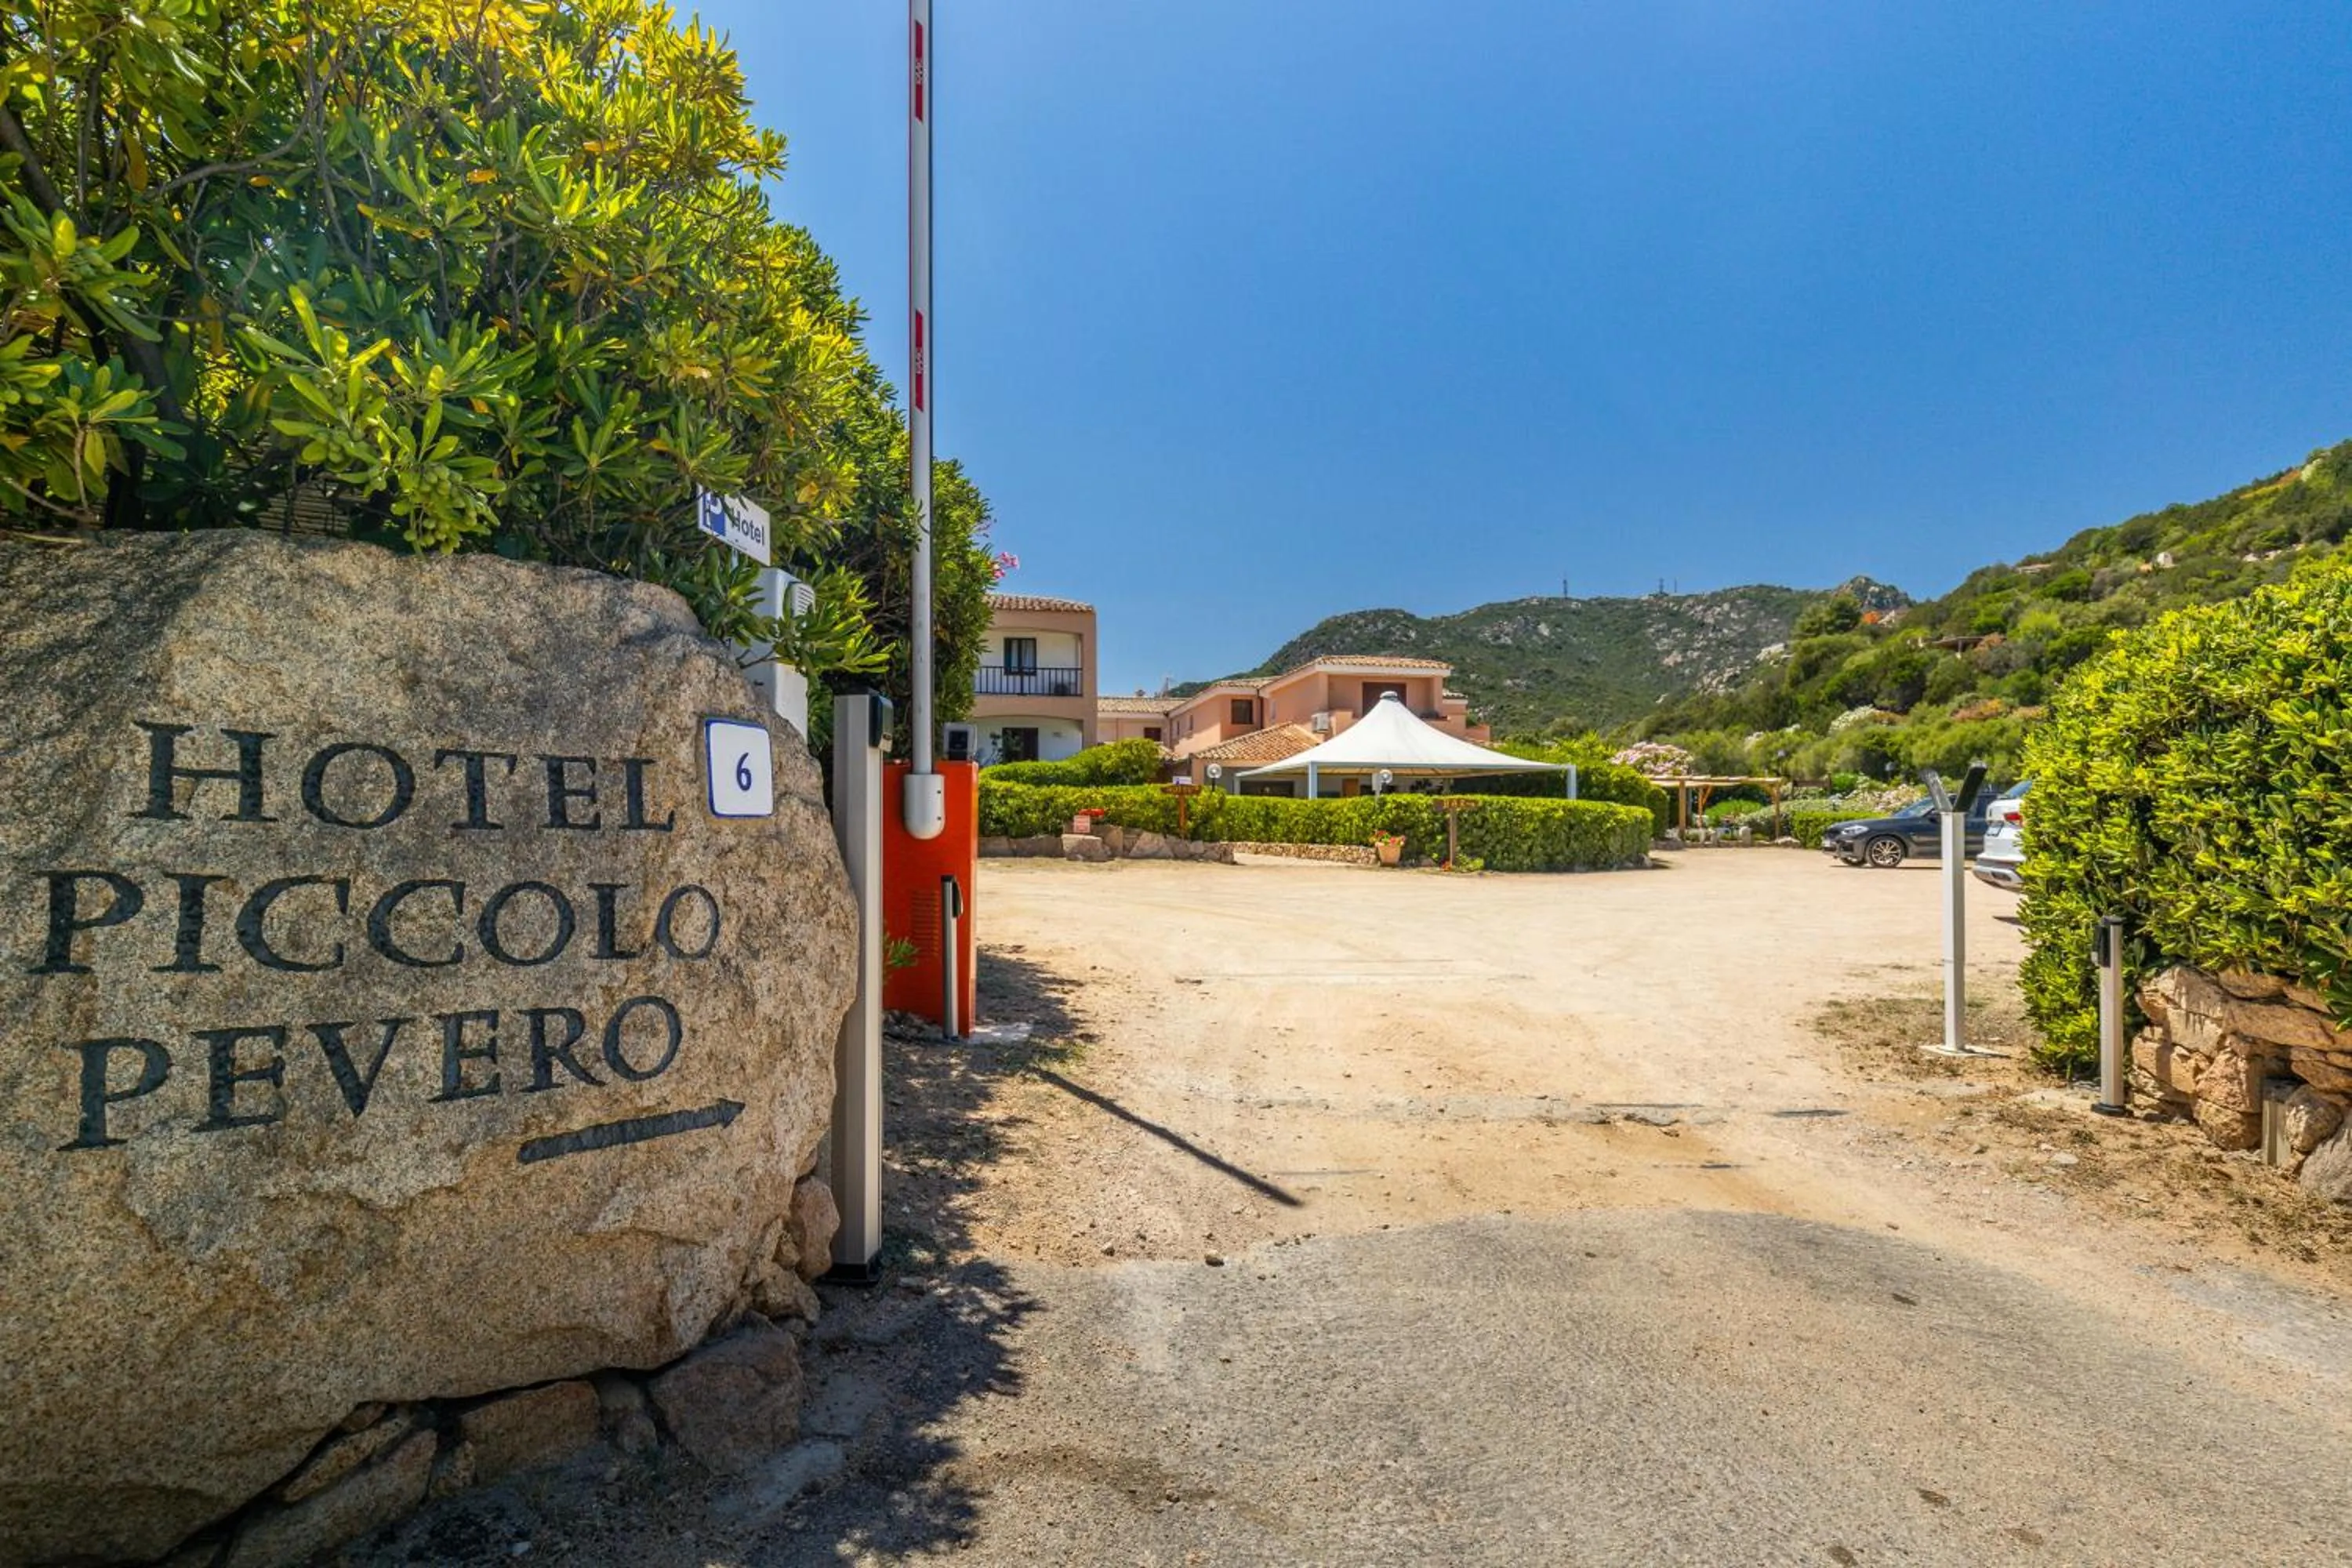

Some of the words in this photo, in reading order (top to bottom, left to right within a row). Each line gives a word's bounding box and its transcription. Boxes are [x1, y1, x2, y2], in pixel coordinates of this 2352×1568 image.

[731, 508, 765, 546] Hotel
[129, 719, 676, 831] HOTEL
[735, 752, 753, 792] 6
[25, 868, 720, 975] PICCOLO
[56, 995, 684, 1152] PEVERO
